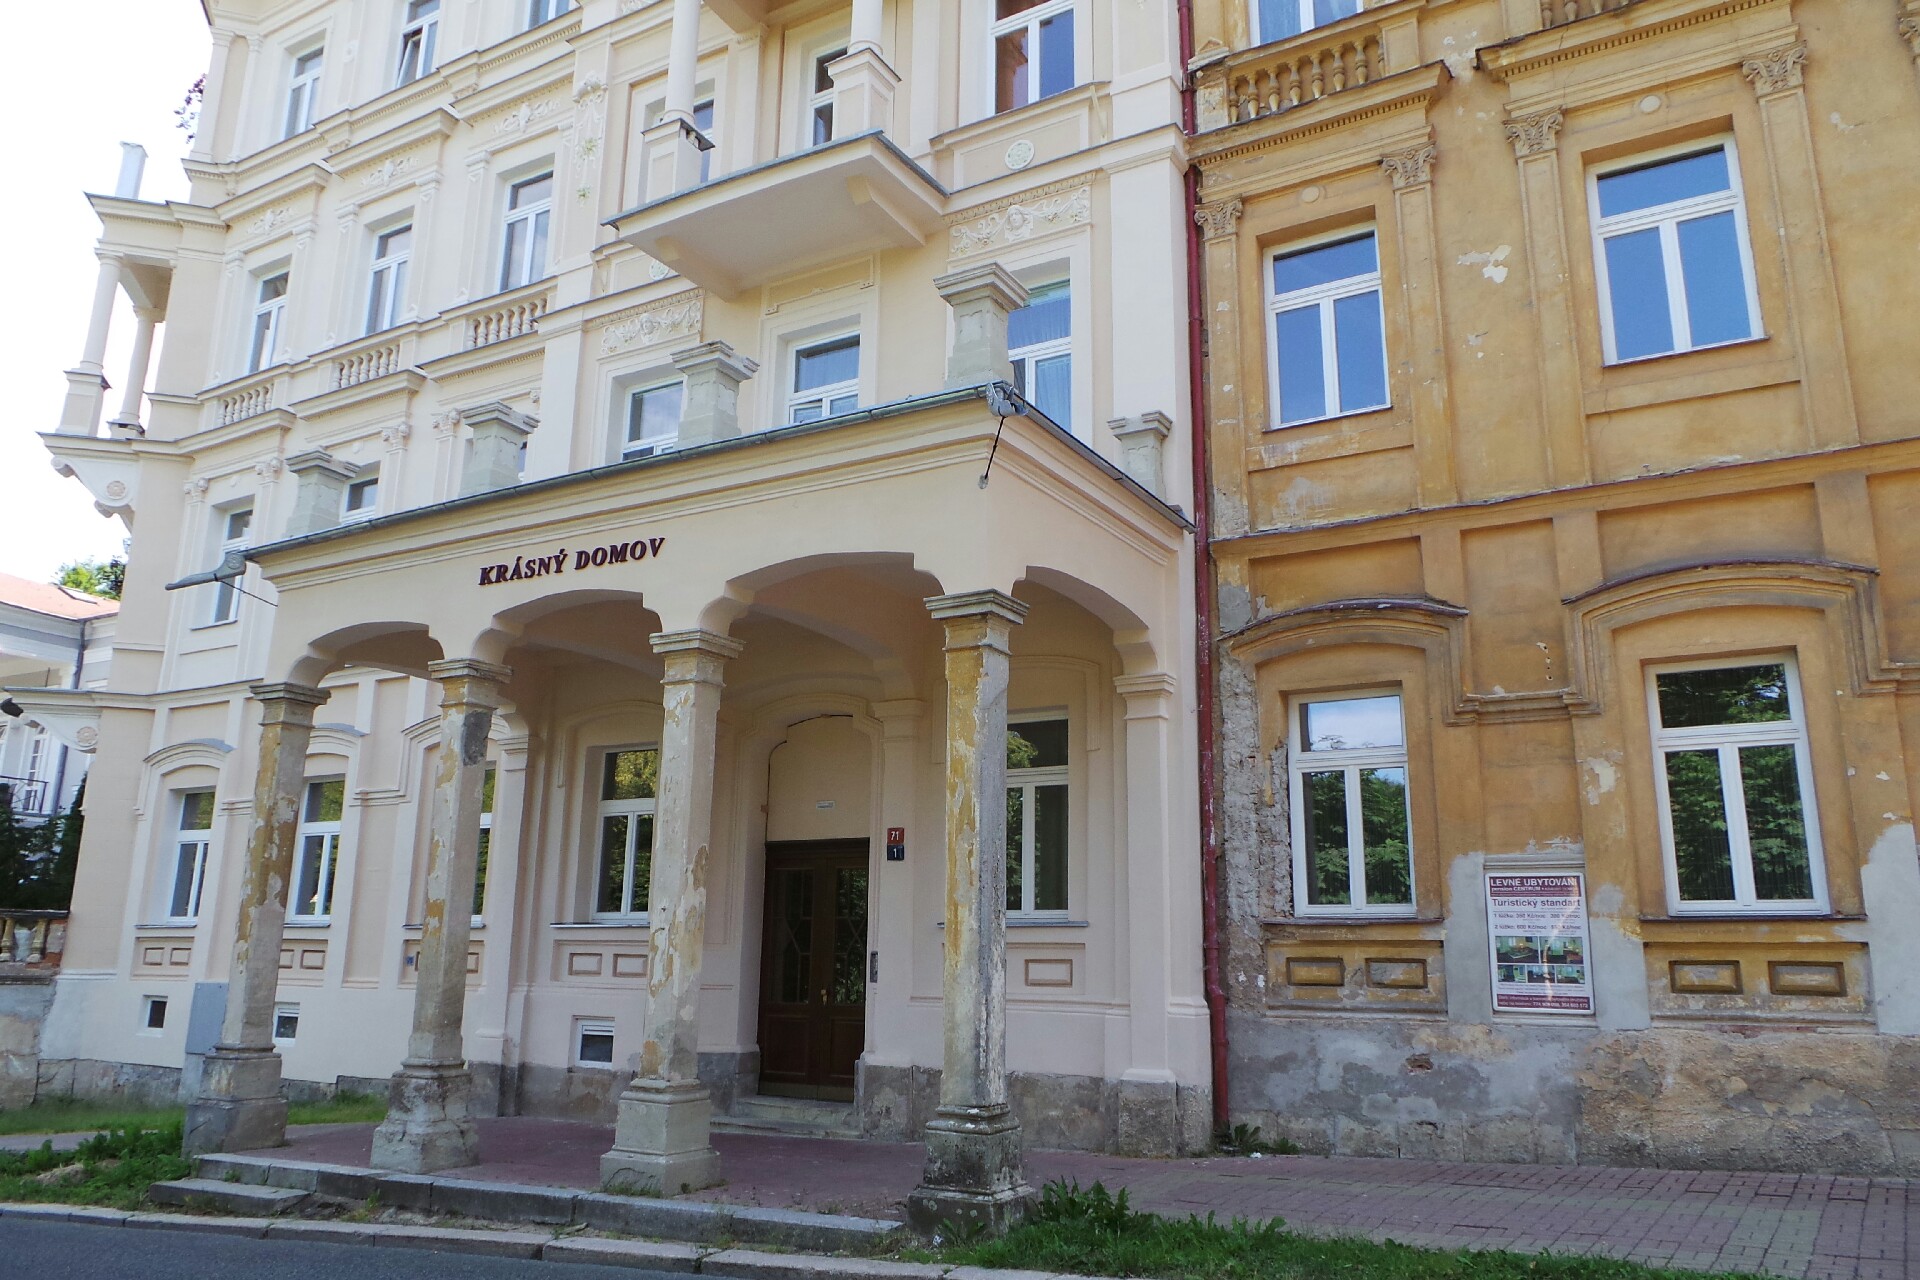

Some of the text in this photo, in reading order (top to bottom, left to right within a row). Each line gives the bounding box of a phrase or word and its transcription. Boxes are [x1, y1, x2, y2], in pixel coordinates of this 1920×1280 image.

[478, 537, 666, 586] KRÁSNÝ DOMOV
[890, 831, 899, 841] 71
[1490, 877, 1577, 886] LEVNÉ UBYTOVÁNÍ
[1492, 898, 1581, 908] Turistický standart
